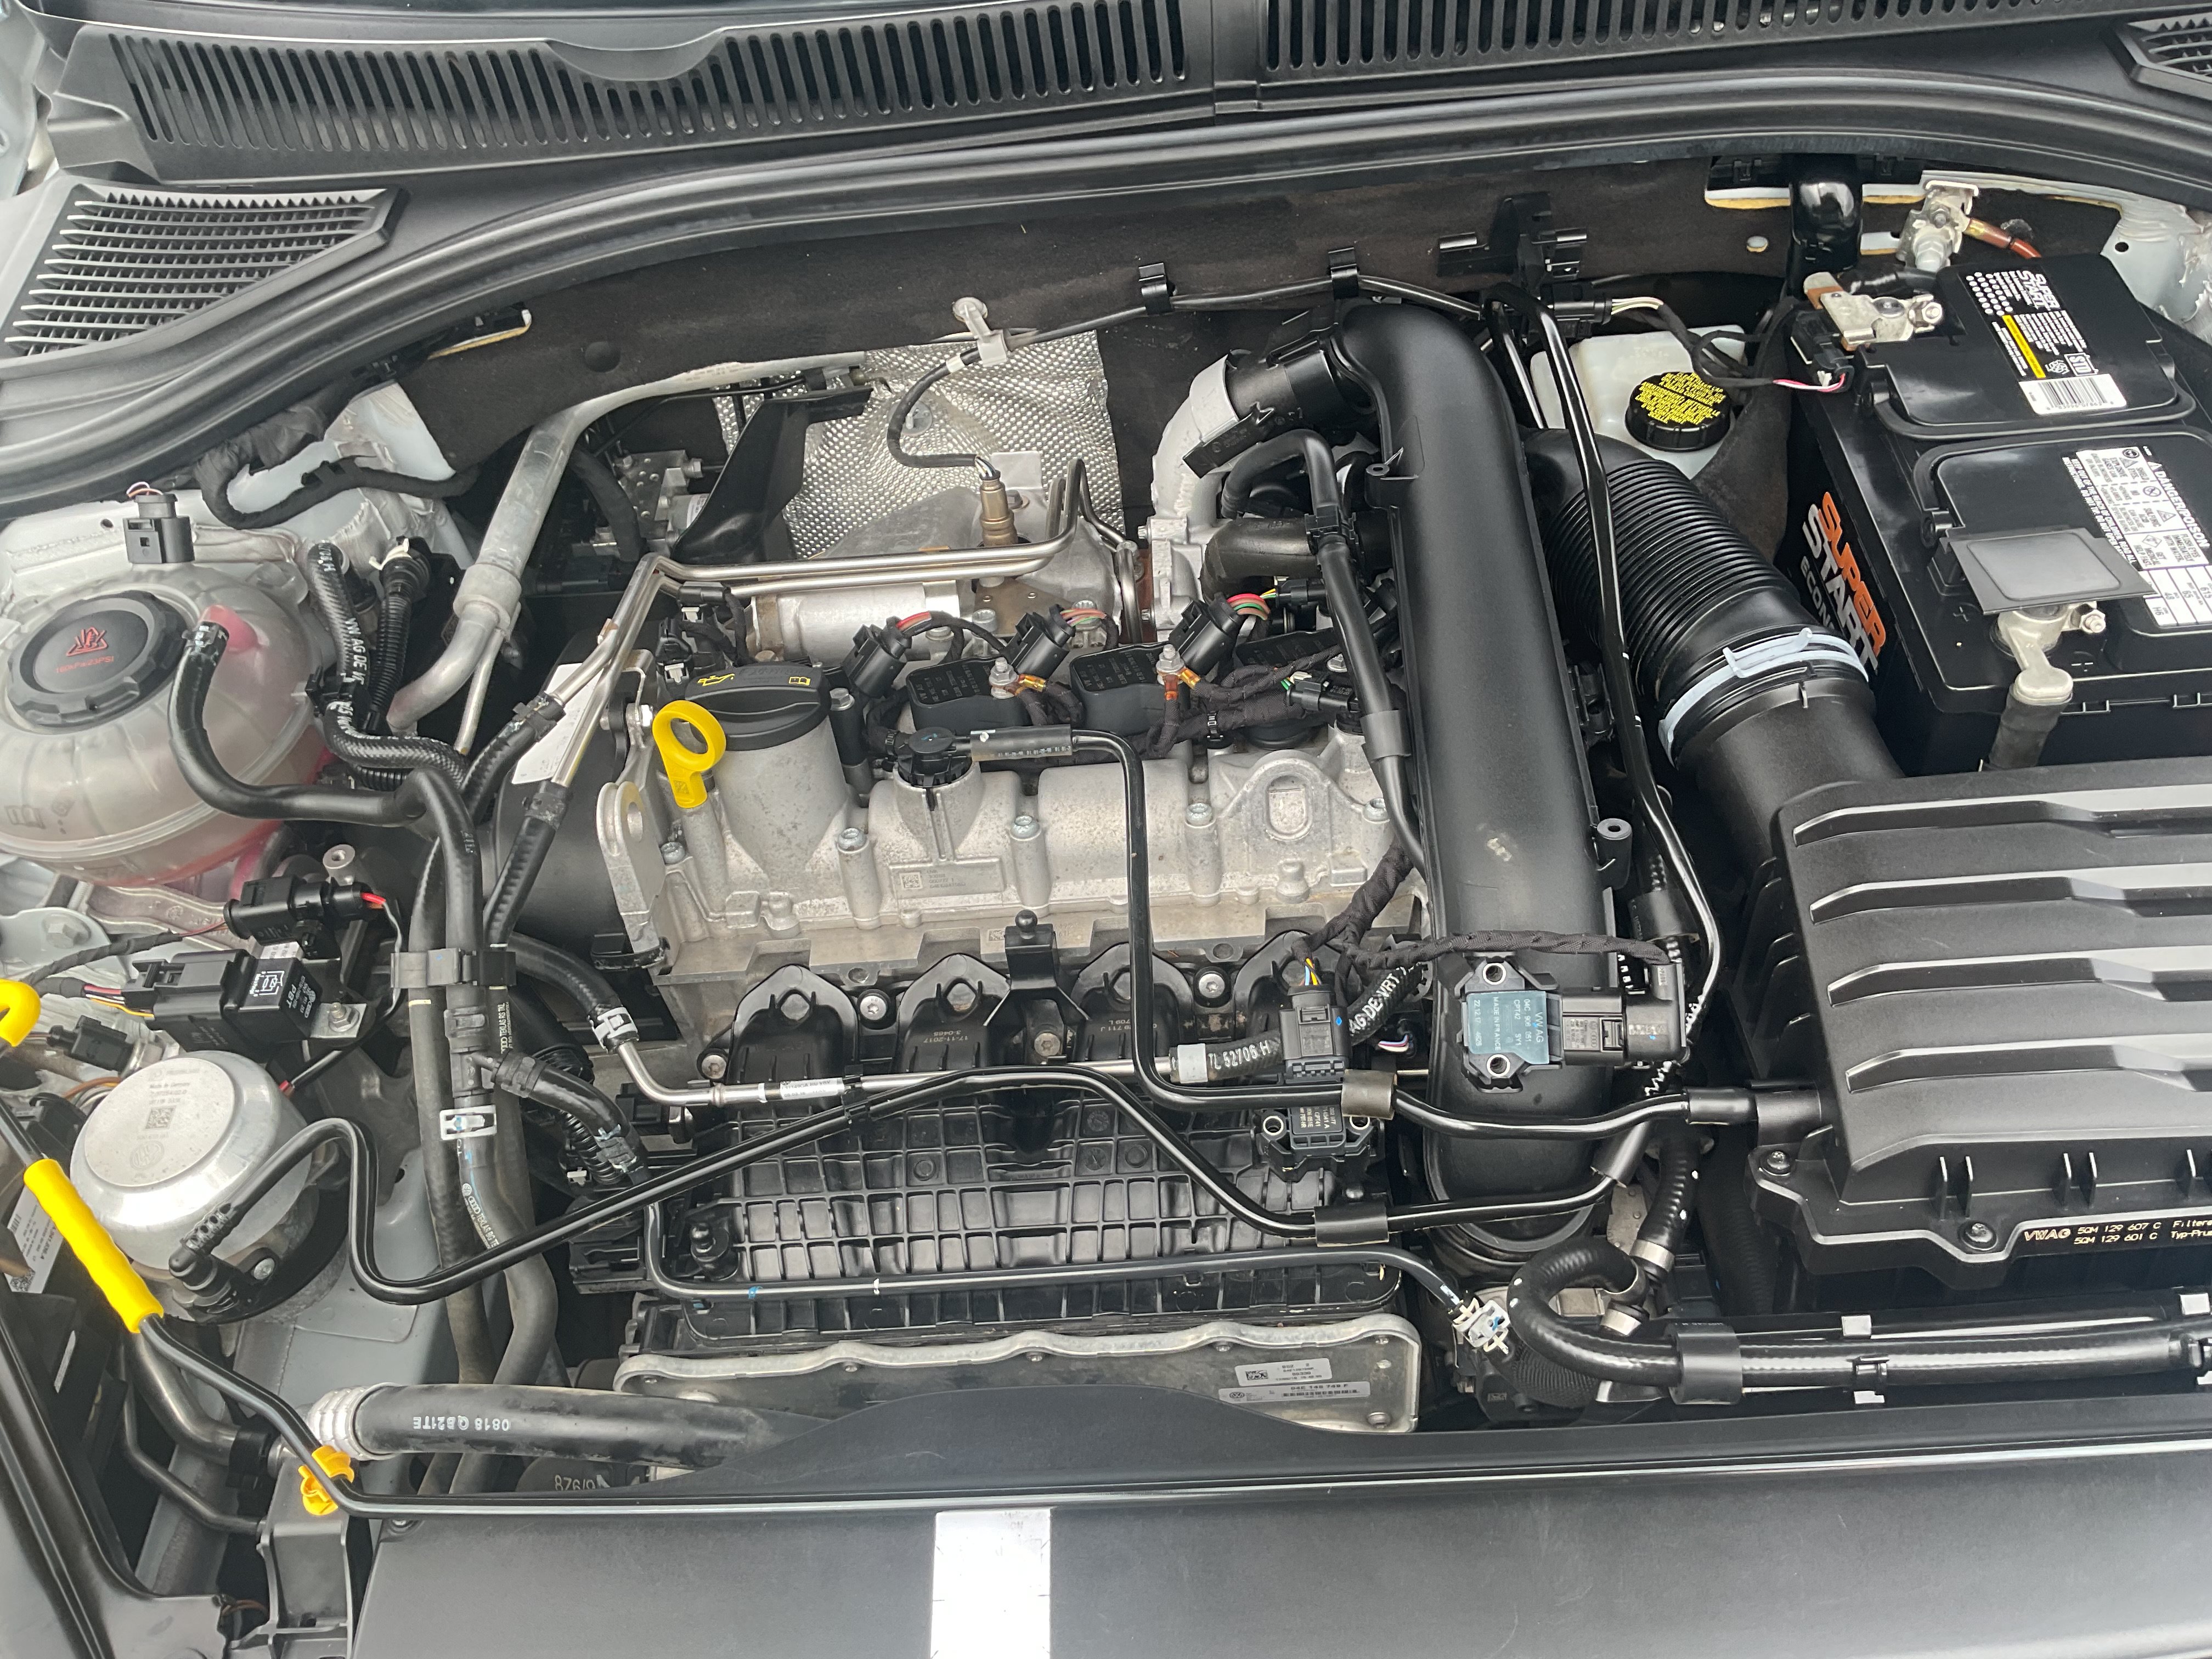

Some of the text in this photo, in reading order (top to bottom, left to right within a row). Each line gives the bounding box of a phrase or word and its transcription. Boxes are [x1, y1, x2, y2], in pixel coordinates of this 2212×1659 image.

[2015, 269, 2053, 312] START
[2030, 273, 2063, 309] SUPER
[2109, 456, 2128, 478] EXPLOSIVE
[2135, 466, 2150, 481] SHIELD
[2069, 458, 2084, 470] KEEP
[2090, 493, 2108, 510] REACH
[2117, 540, 2133, 554] READ
[2142, 507, 2162, 527] SULFURIC
[2153, 469, 2210, 549] DANGER/POISON
[2162, 534, 2176, 546] WITH
[2171, 534, 2194, 562] IMMEDIATELY
[2179, 533, 2200, 558] FLUSH EYES
[2142, 547, 2162, 566] MEDICAL
[1818, 492, 1887, 657] SUPER
[1802, 504, 1878, 671] START
[2182, 590, 2194, 599] 65
[2152, 606, 2164, 616] H6
[351, 637, 366, 653] AG
[353, 654, 368, 671] DE
[286, 984, 297, 1008] PBT
[1347, 973, 1400, 1034] AG DE VRT
[499, 1019, 507, 1037] TEKLAS
[1534, 1012, 1544, 1043] VW AG
[1208, 1040, 1272, 1070] TL 52706 H
[476, 1212, 492, 1233] TEKLAS
[485, 1231, 495, 1241] BG
[2101, 1235, 2120, 1243] 129
[2124, 1233, 2143, 1242] 601
[2149, 1232, 2158, 1240] C
[2104, 1224, 2124, 1233] 129
[2128, 1222, 2149, 1232] 607
[2153, 1221, 2162, 1229] C
[413, 1415, 510, 1431] 0818 QB21TE
